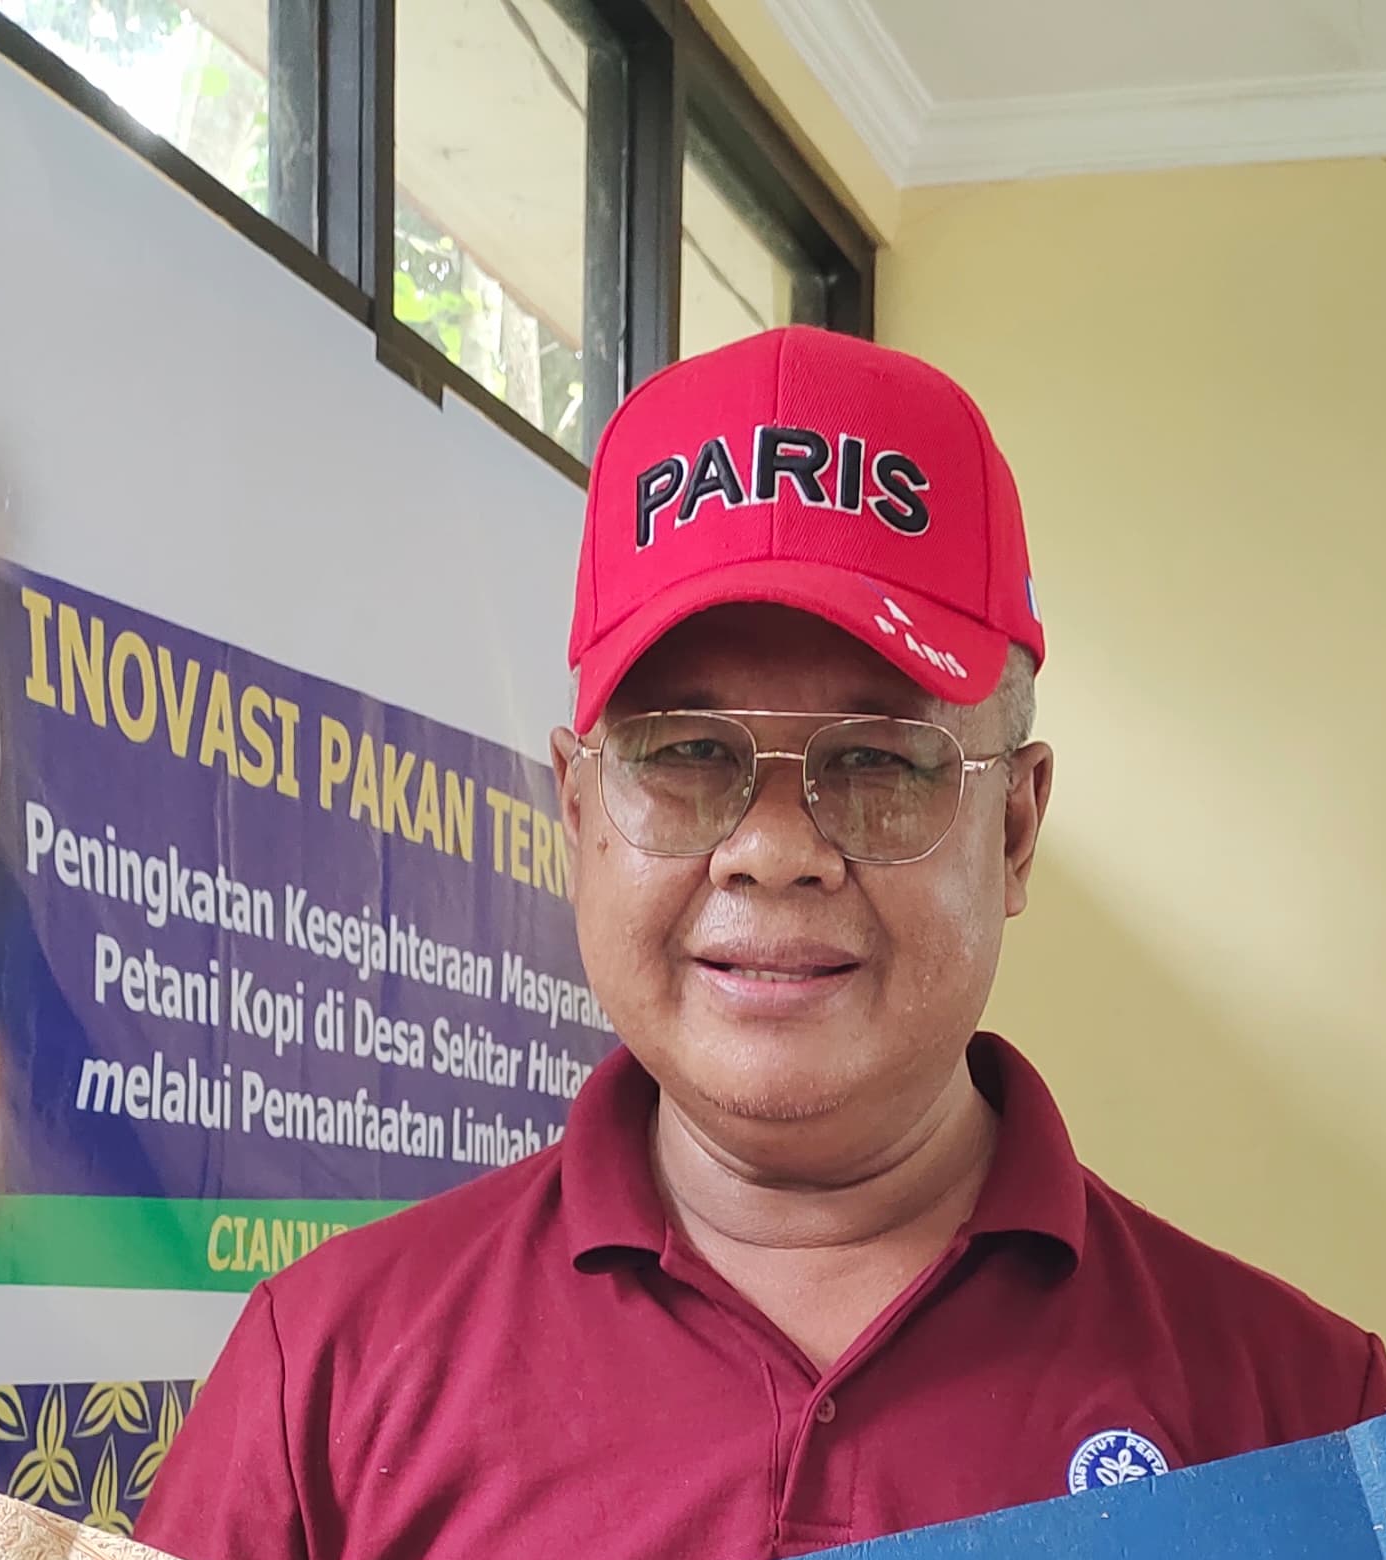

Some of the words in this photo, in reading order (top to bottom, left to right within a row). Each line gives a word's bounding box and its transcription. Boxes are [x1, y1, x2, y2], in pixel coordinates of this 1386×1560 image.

[636, 423, 930, 553] PARIS
[21, 586, 301, 798] INOVASI
[319, 715, 475, 862] PAKAN
[24, 801, 274, 939] Peningkatan
[284, 884, 493, 1000] Kesejahteraan
[94, 934, 220, 1026] Petani
[230, 968, 304, 1056] Kopi
[314, 990, 345, 1053] di
[354, 998, 425, 1069] Desa
[432, 1017, 523, 1089] Sekitar
[75, 1052, 231, 1130] melalui
[242, 1070, 445, 1158] Pemanfaatan
[452, 1107, 541, 1168] Limbah
